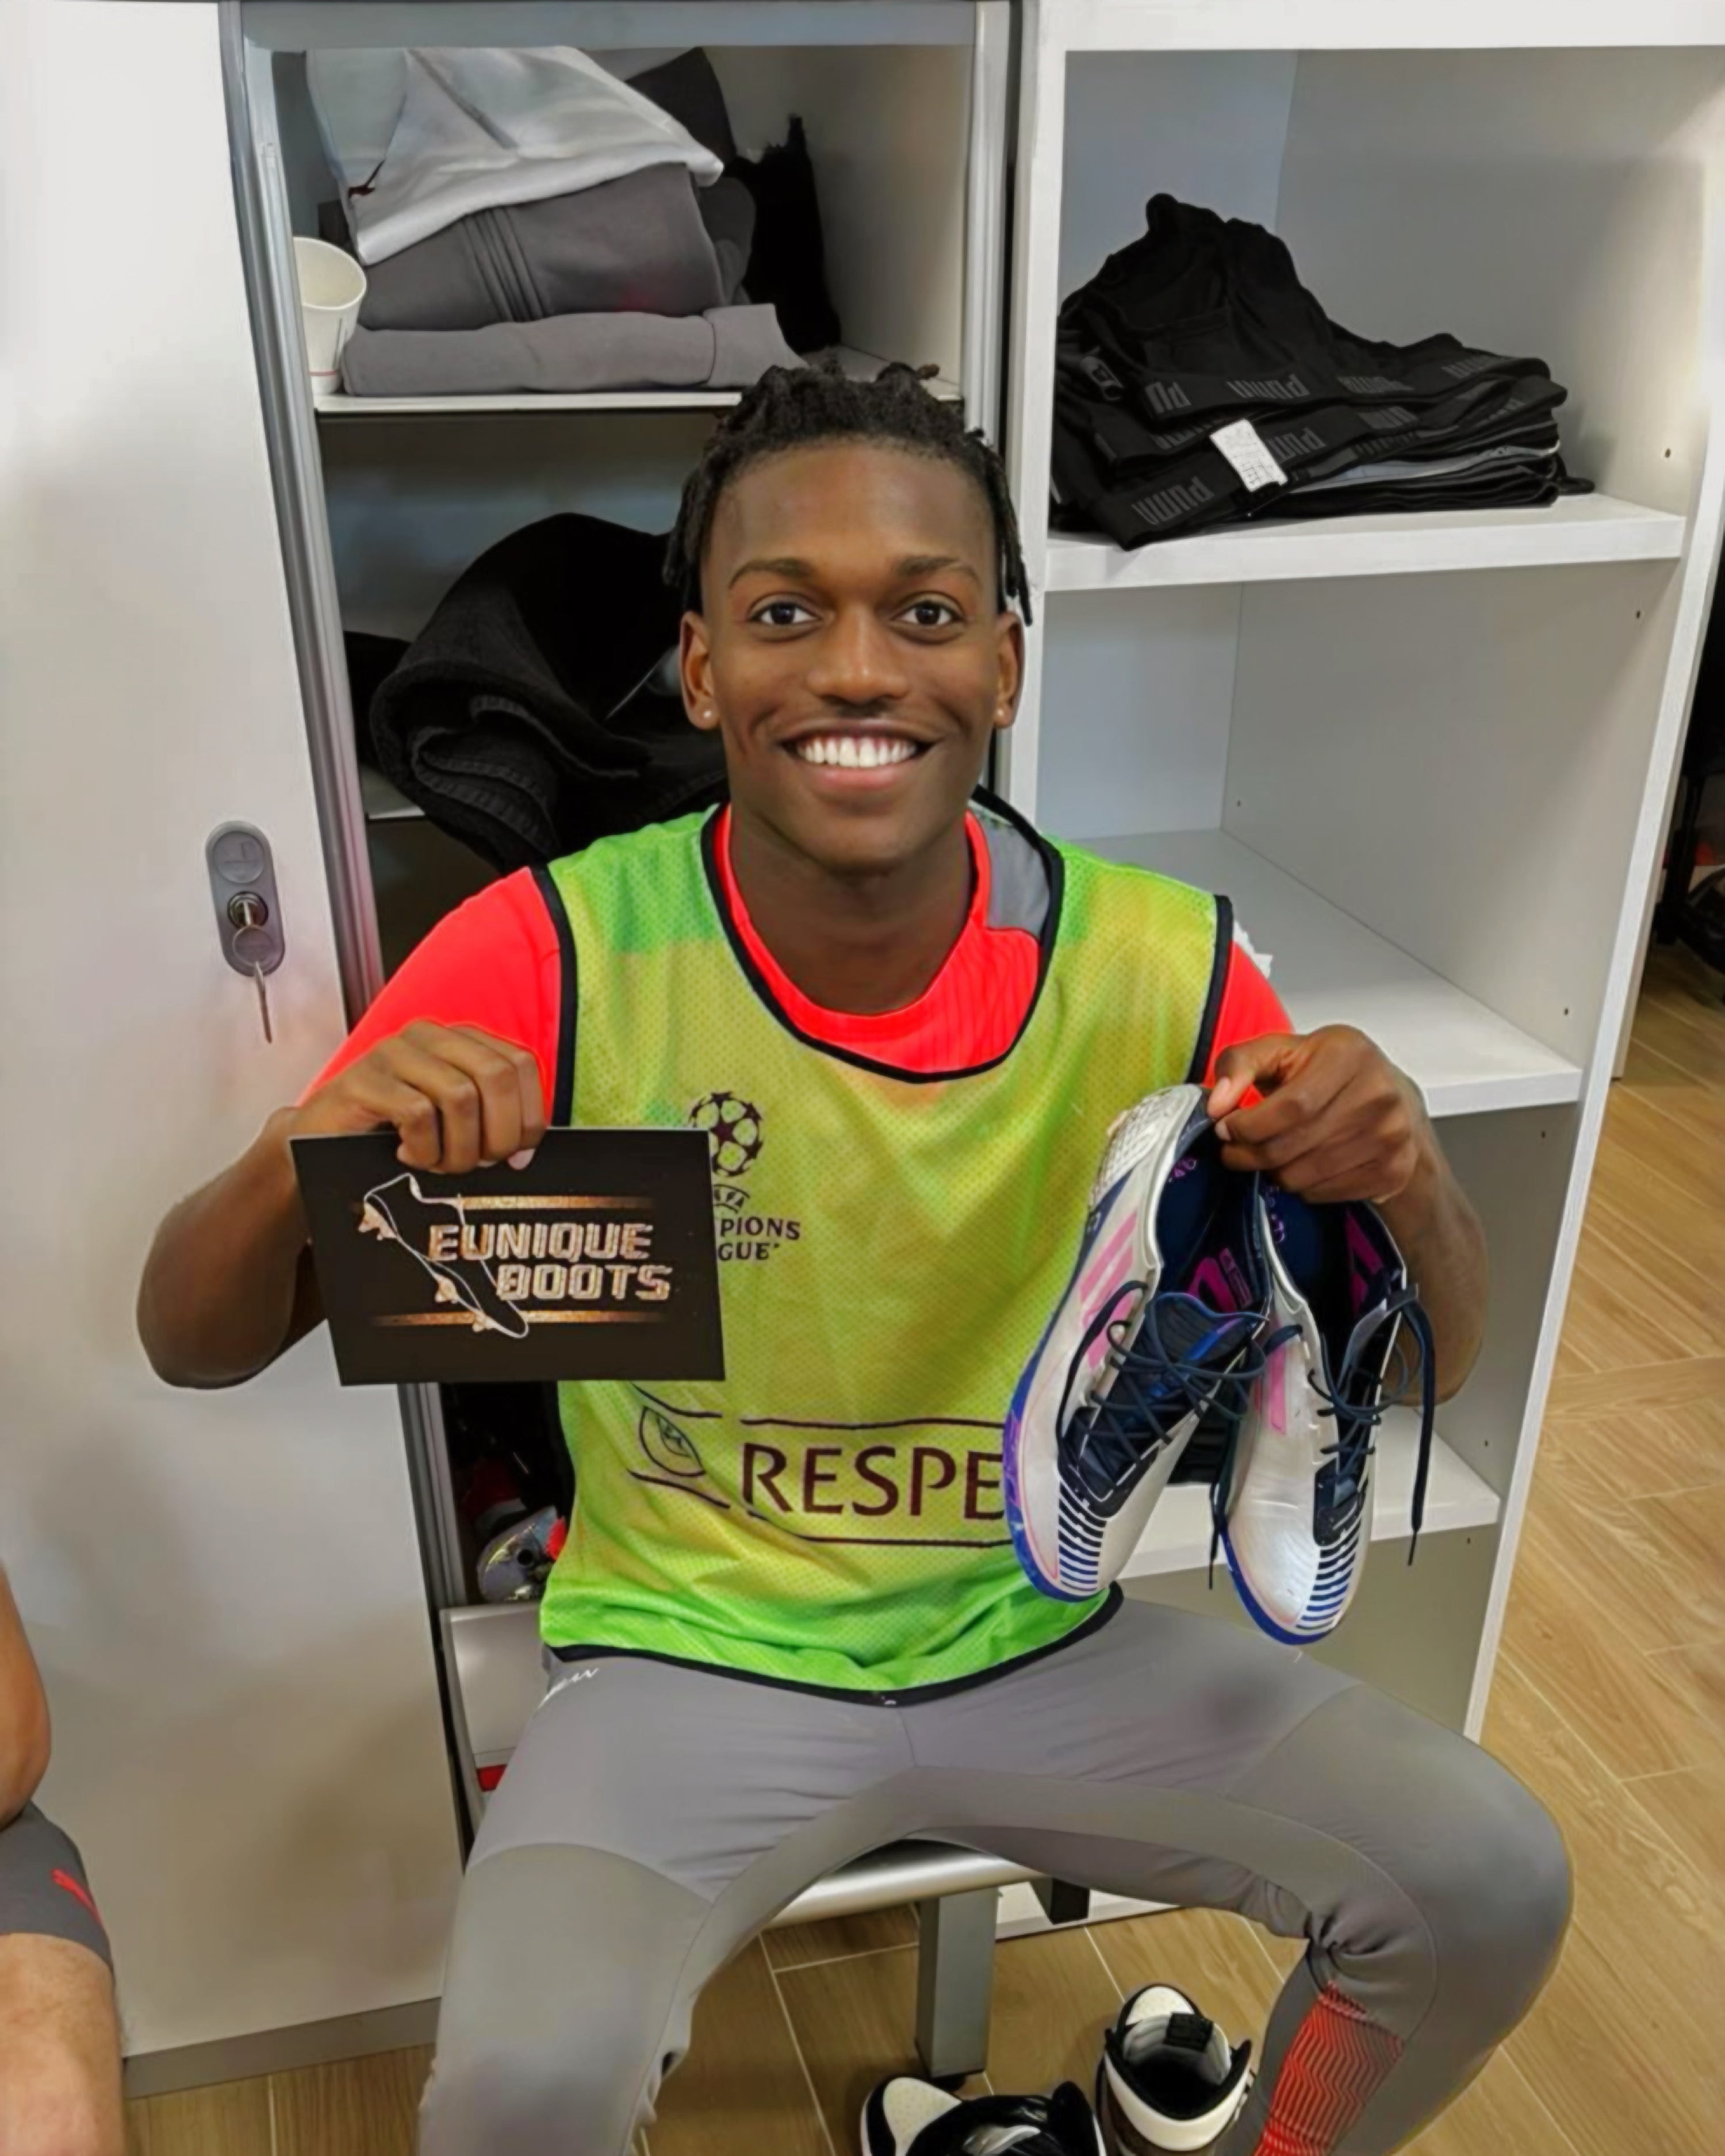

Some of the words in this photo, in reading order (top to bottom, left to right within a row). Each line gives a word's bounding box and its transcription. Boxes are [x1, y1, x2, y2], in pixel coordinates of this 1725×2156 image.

[1144, 382, 1191, 413] PU
[1131, 476, 1214, 524] PUMA
[428, 1223, 653, 1261] EUNIQUE
[720, 1217, 800, 1240] PIONS
[719, 1242, 769, 1261] GUE
[497, 1264, 672, 1300] BOOTS
[742, 1443, 1005, 1519] RESPE
